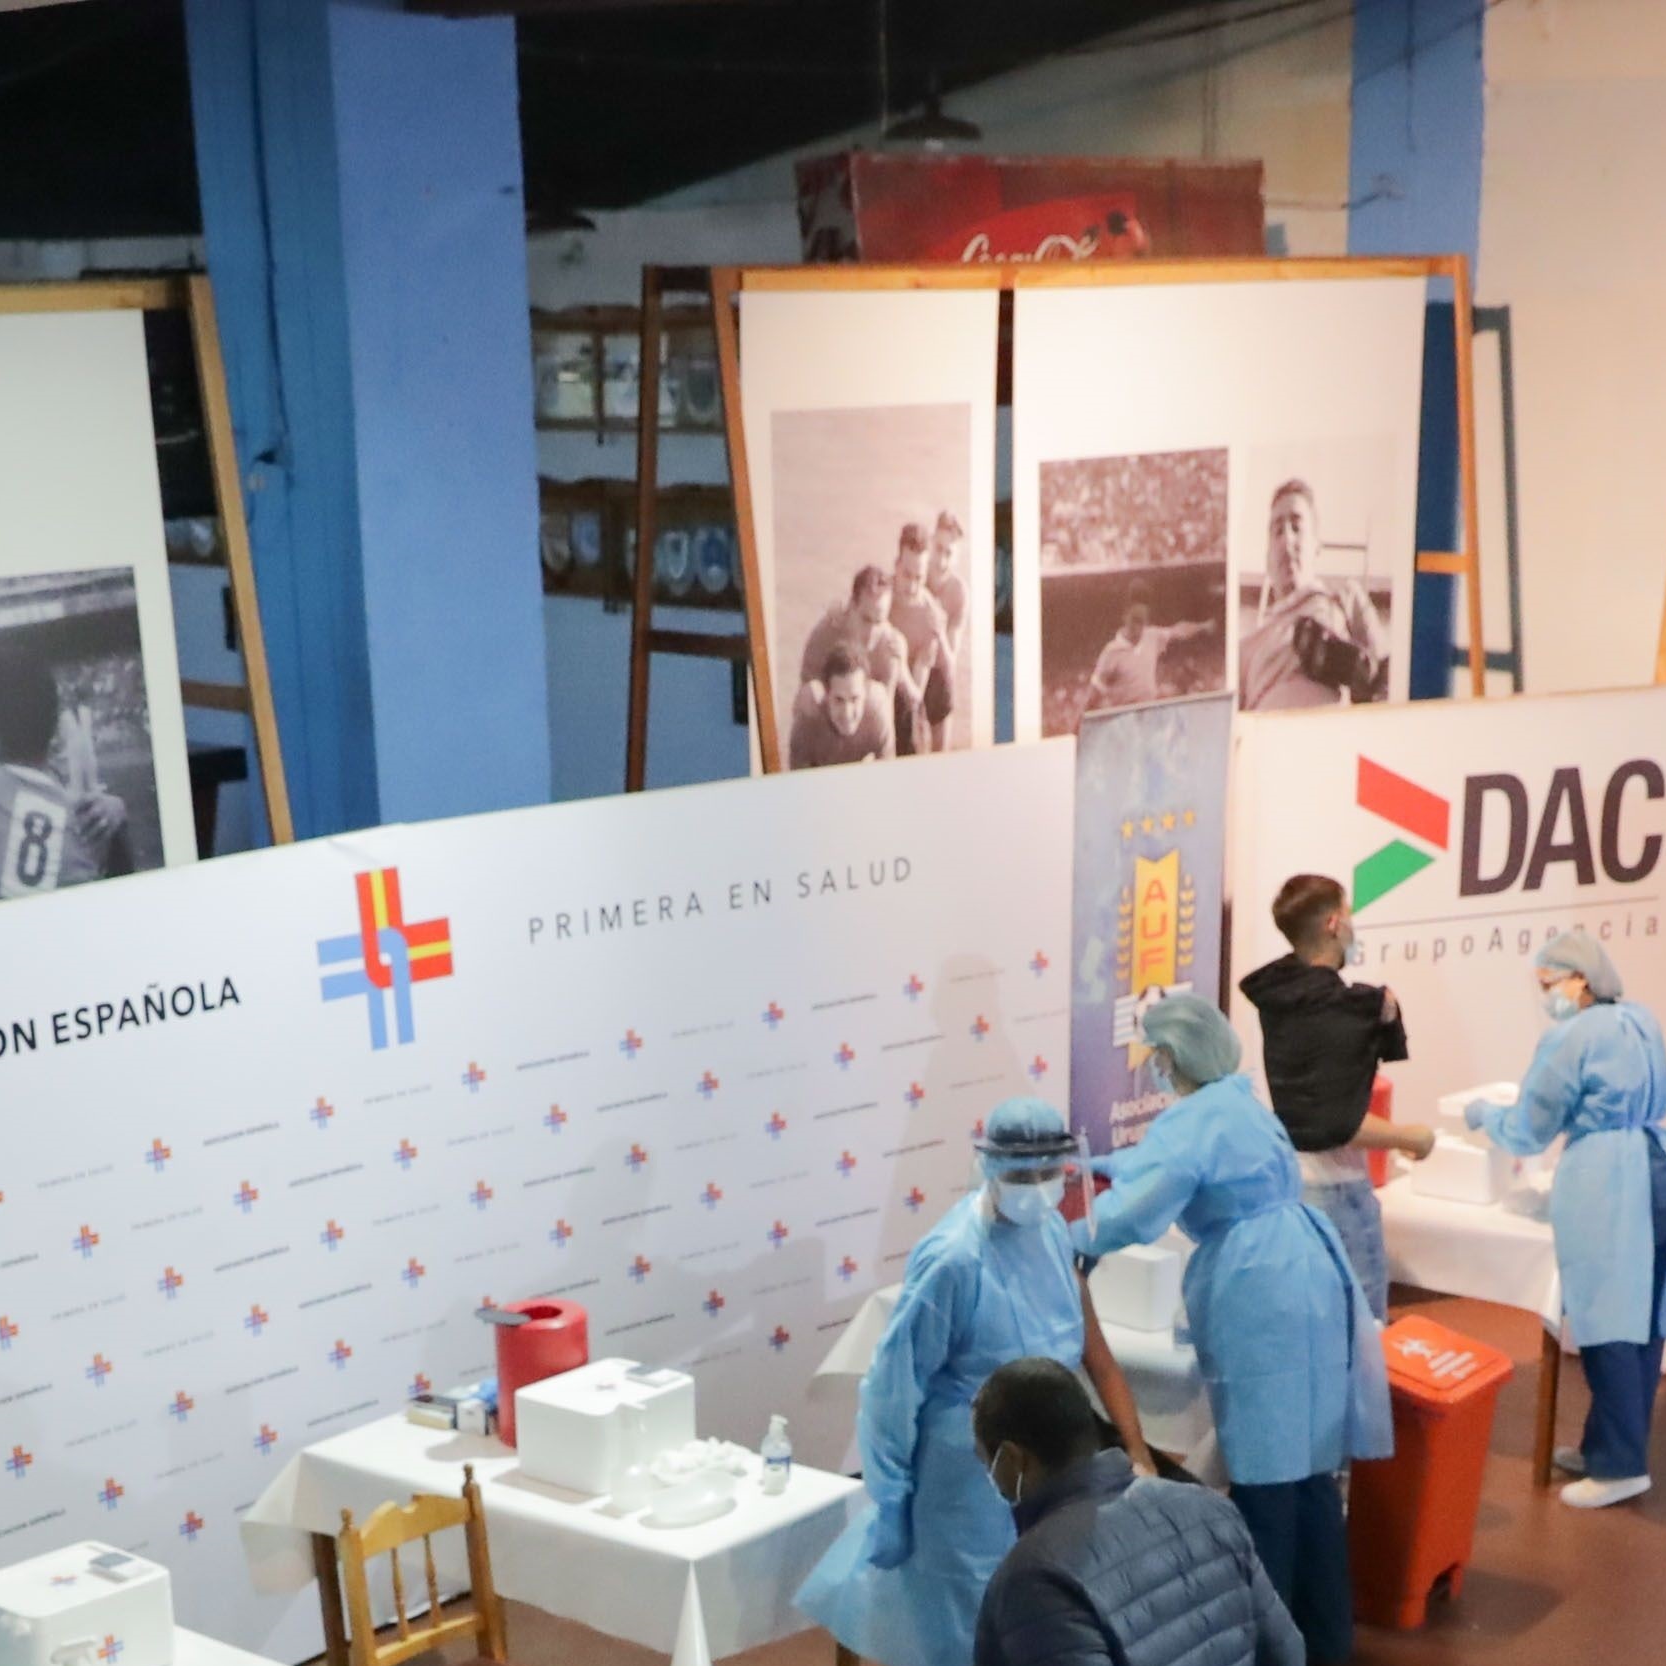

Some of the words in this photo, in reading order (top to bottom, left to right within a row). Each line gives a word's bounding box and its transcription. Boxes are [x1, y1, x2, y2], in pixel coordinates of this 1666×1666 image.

[17, 811, 53, 887] 8
[1459, 760, 1665, 898] DAC
[528, 892, 704, 945] PRIMERA
[730, 879, 772, 910] EN
[797, 856, 912, 899] SALUD
[1139, 878, 1168, 978] AUF
[52, 975, 241, 1045] ESPAÑOLA
